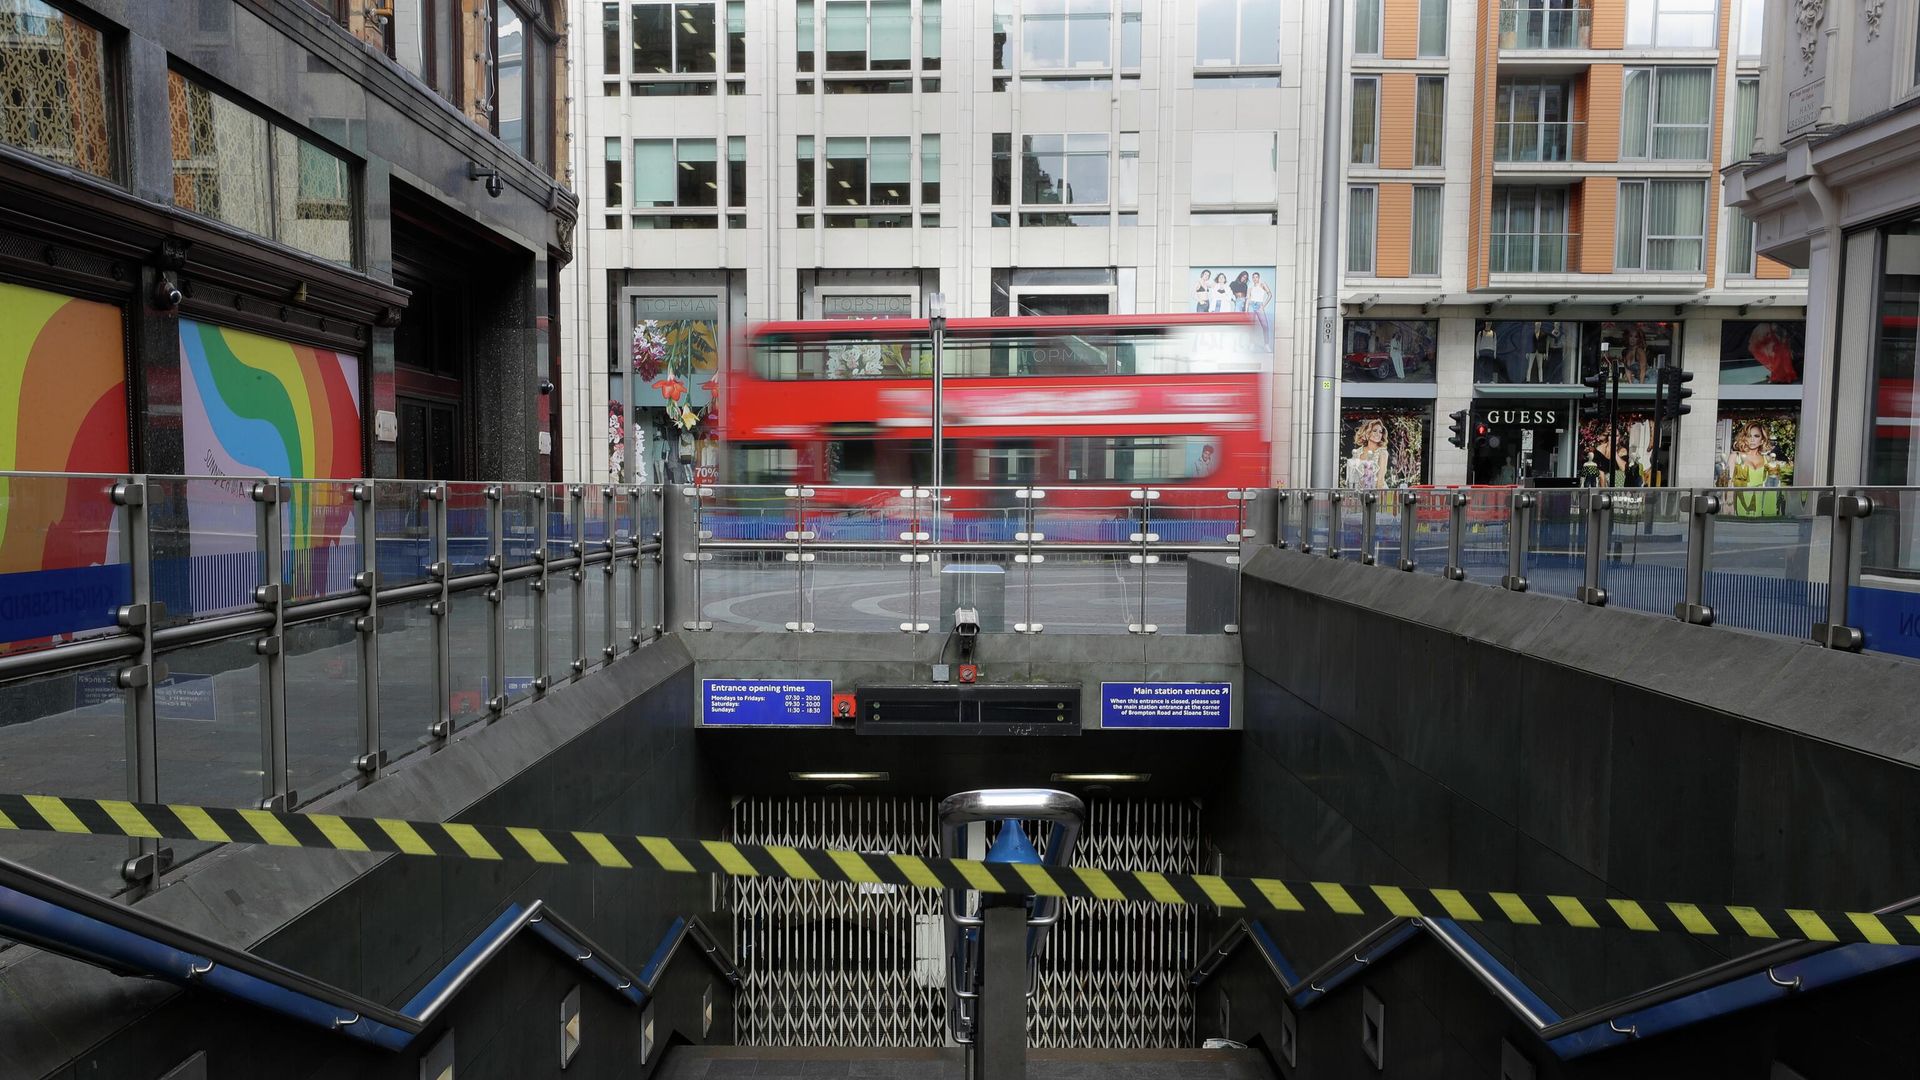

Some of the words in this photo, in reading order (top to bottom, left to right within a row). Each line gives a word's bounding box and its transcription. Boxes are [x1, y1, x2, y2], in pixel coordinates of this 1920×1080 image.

[831, 297, 911, 311] TOPSHOP
[1487, 410, 1556, 424] GUESS
[695, 467, 720, 478] 70%
[711, 684, 747, 692] Entrance
[748, 684, 781, 694] opening
[782, 684, 806, 692] times
[1133, 687, 1152, 695] Main
[1154, 687, 1183, 695] station
